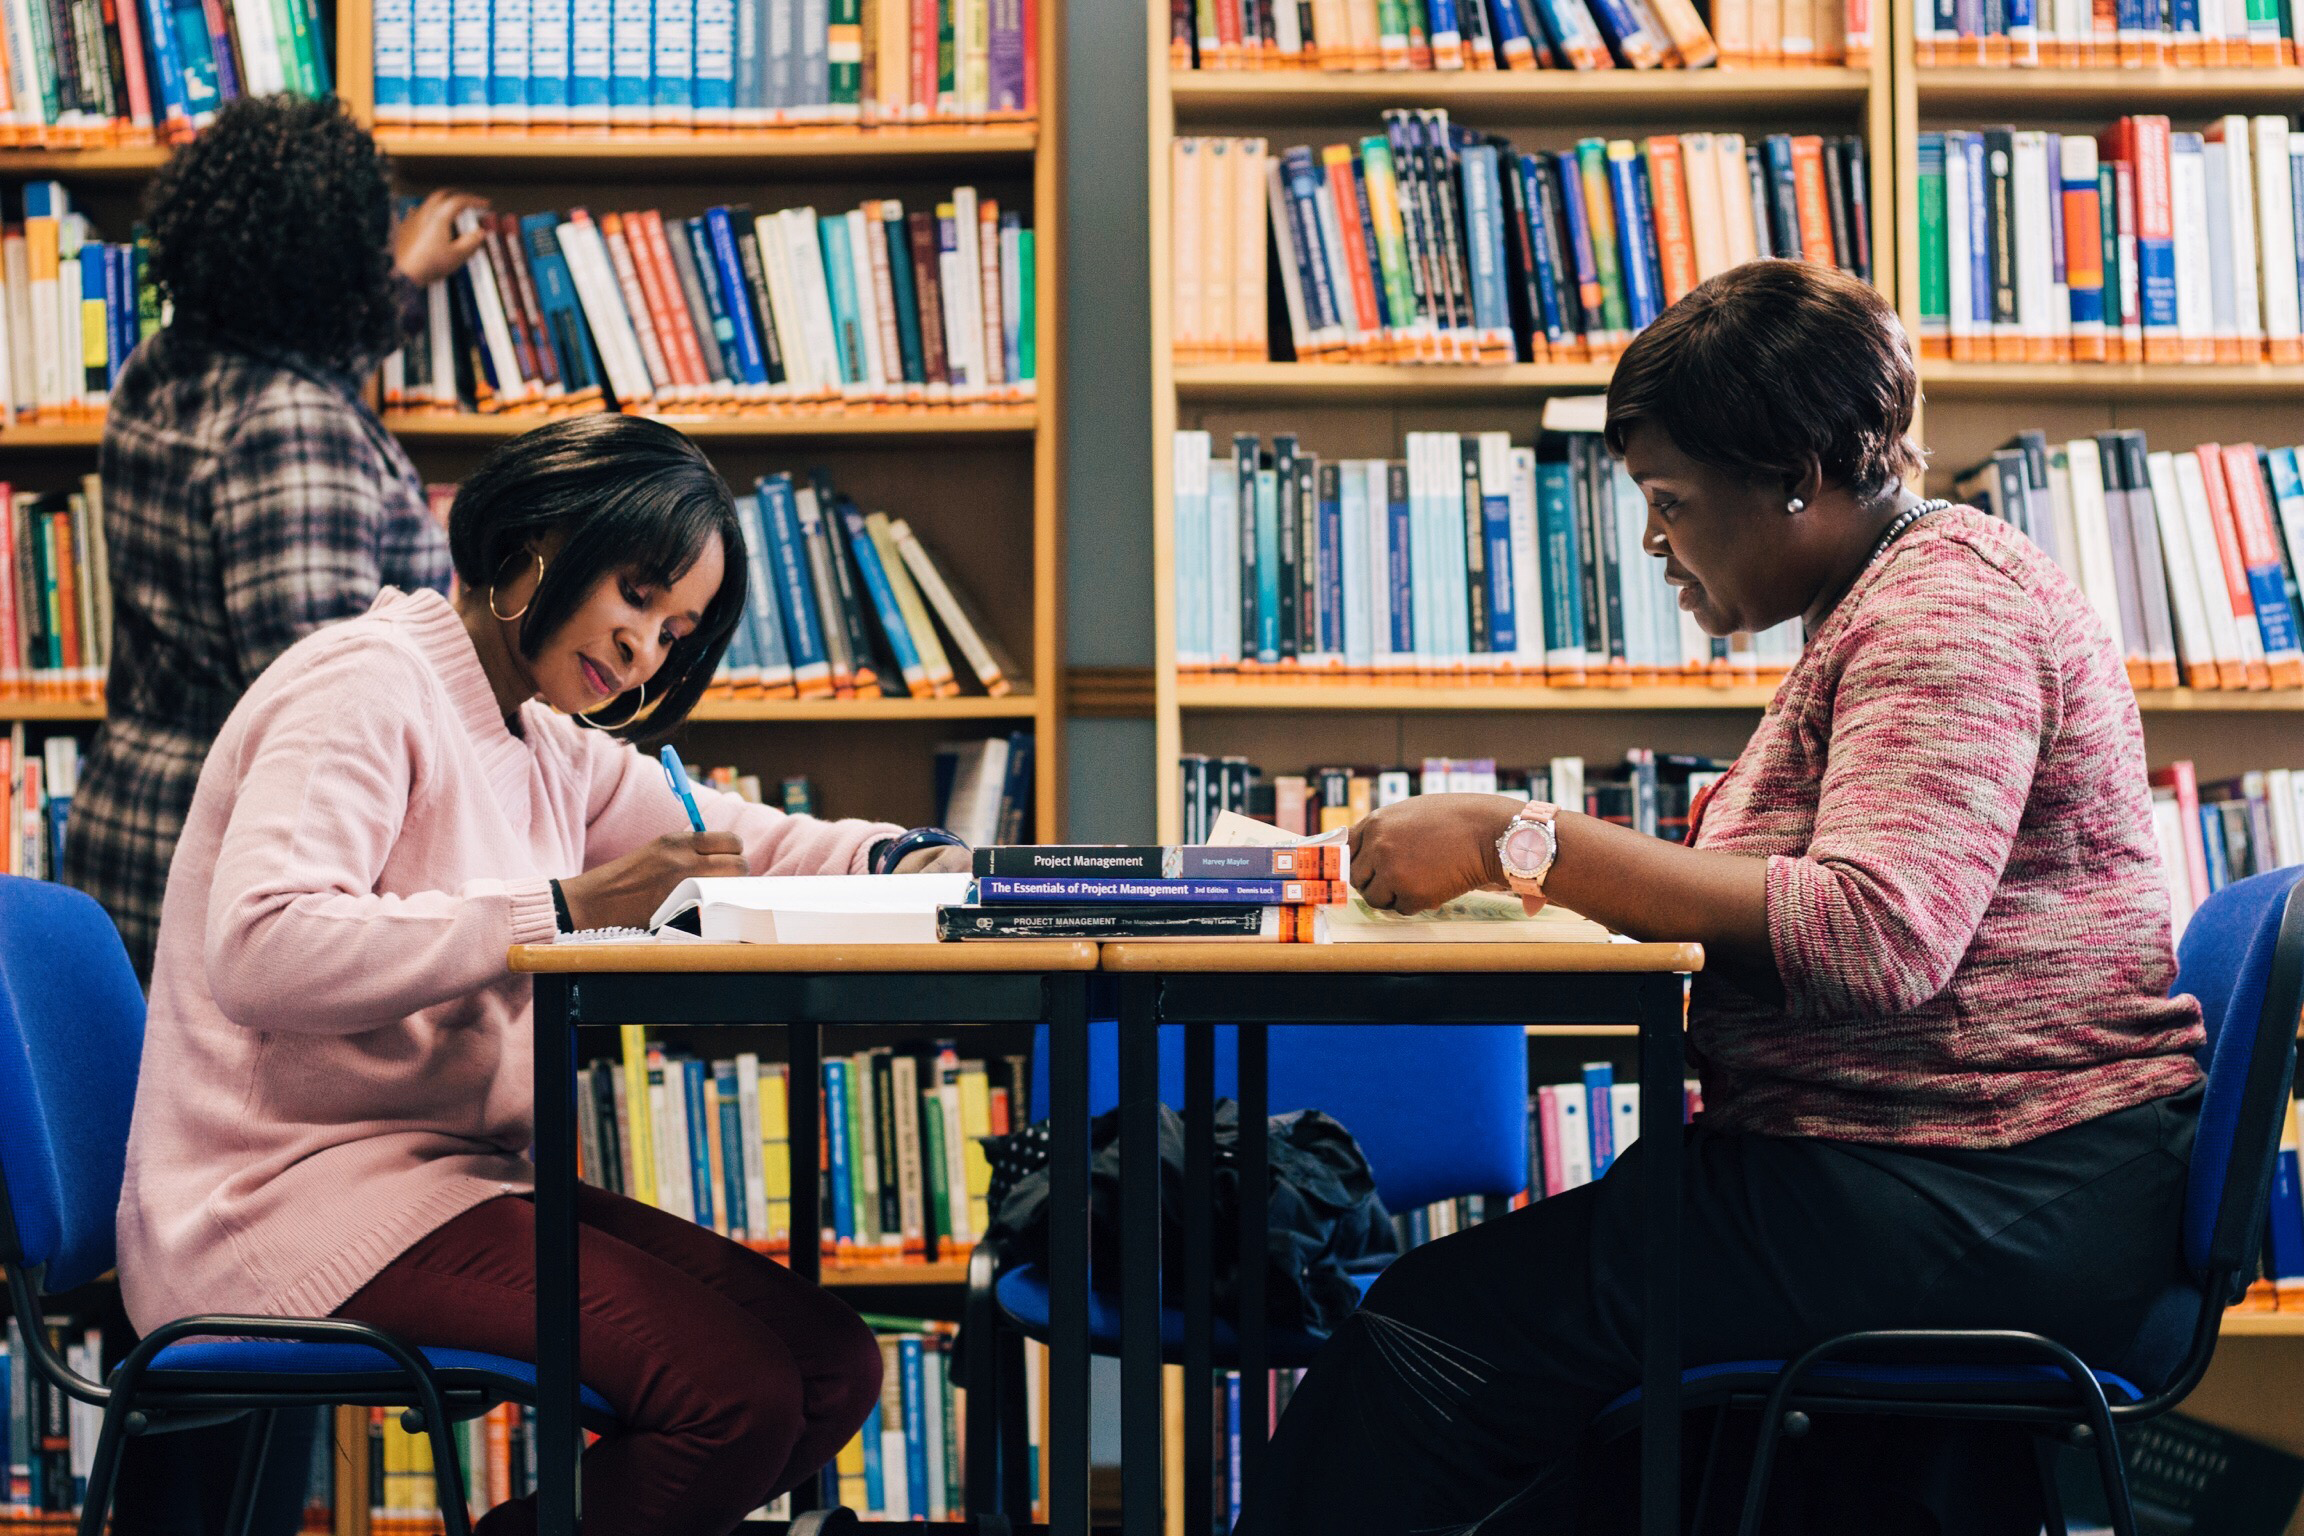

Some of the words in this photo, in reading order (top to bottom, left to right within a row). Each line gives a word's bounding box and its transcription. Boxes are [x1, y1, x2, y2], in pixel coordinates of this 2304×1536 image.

[1034, 855, 1071, 868] Project
[1073, 855, 1143, 868] Management
[1202, 858, 1225, 866] Harvey
[1226, 858, 1250, 866] Maylor
[991, 882, 1011, 893] The
[1013, 882, 1065, 893] Essentials
[1067, 882, 1080, 893] of
[1081, 883, 1118, 896] Project
[1120, 884, 1188, 897] Management
[1013, 917, 1053, 926] PROJECT
[1055, 917, 1116, 926] MANAGEMENT
